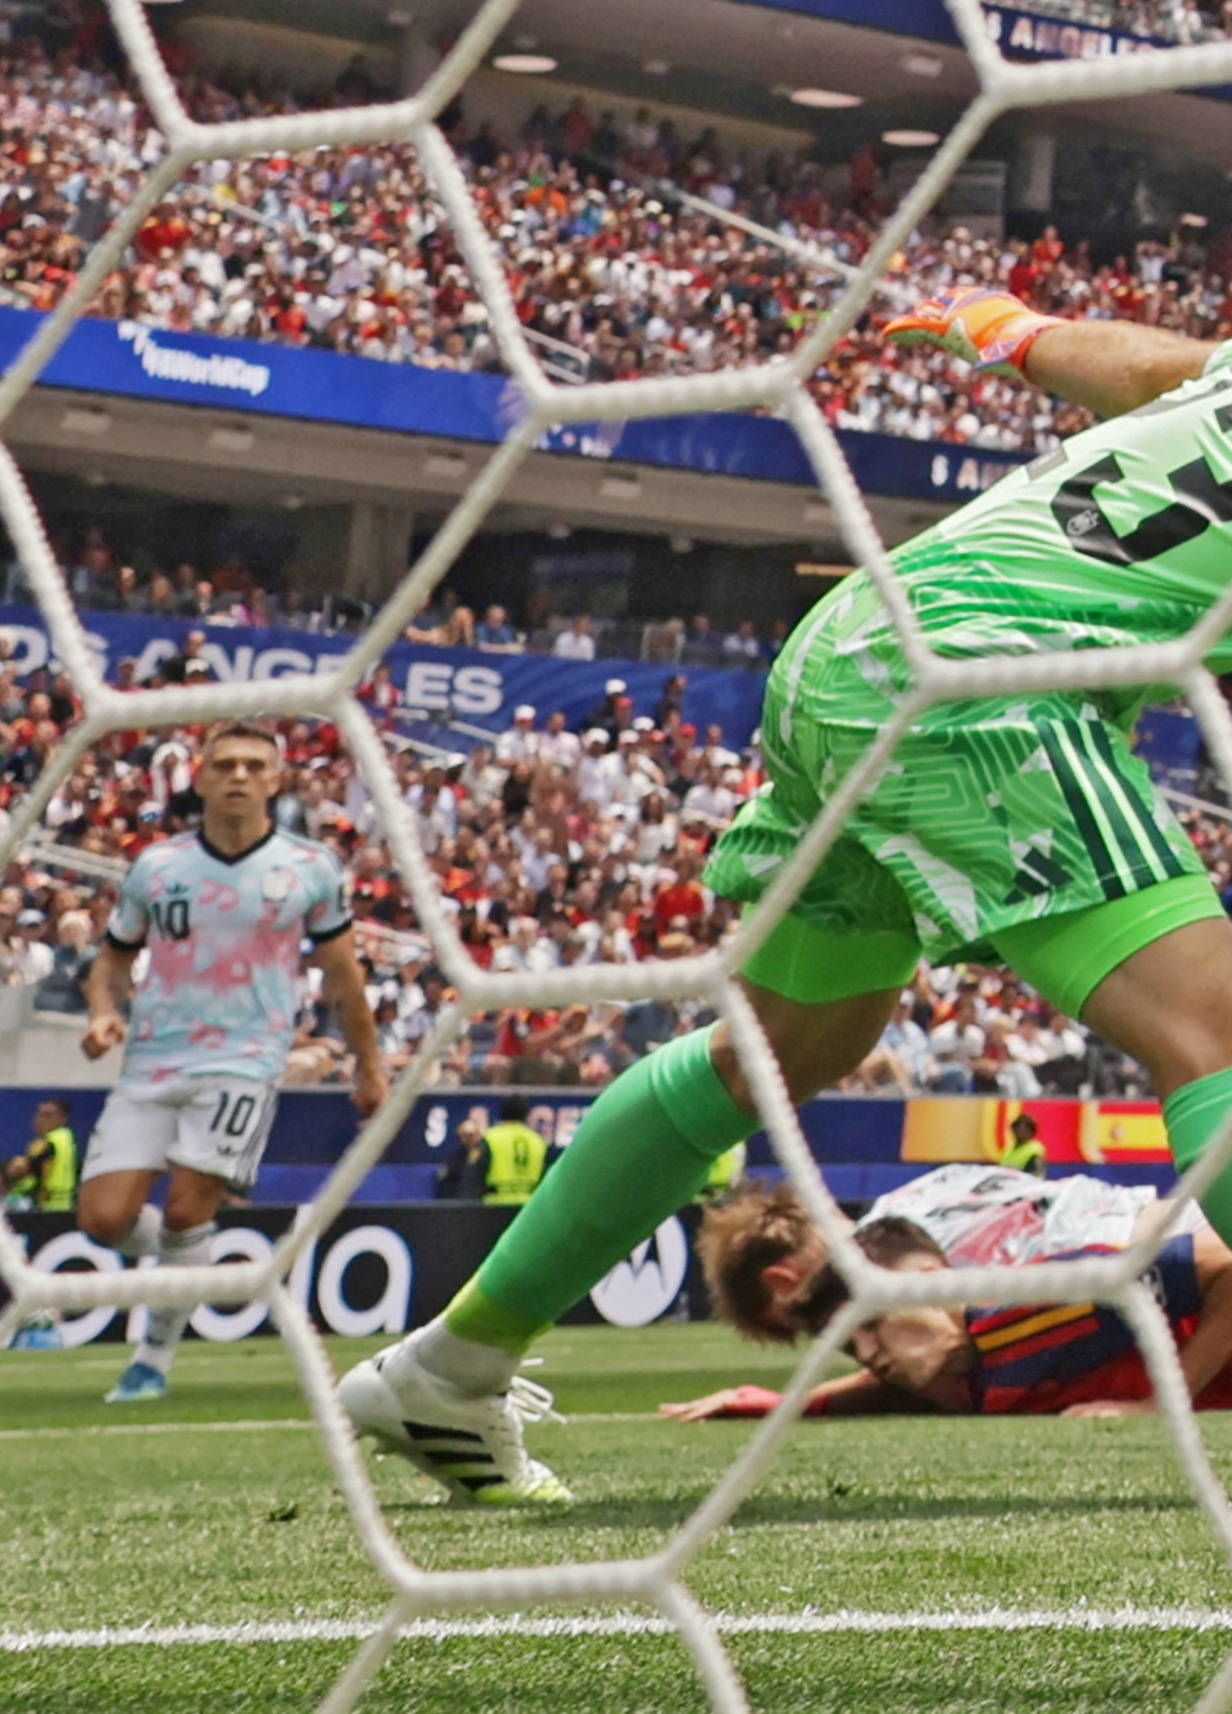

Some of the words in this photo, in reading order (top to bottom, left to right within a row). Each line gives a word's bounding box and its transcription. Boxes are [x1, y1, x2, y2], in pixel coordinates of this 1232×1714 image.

[136, 639, 504, 713] ANGEES
[152, 899, 190, 940] 10
[210, 1091, 255, 1136] 10
